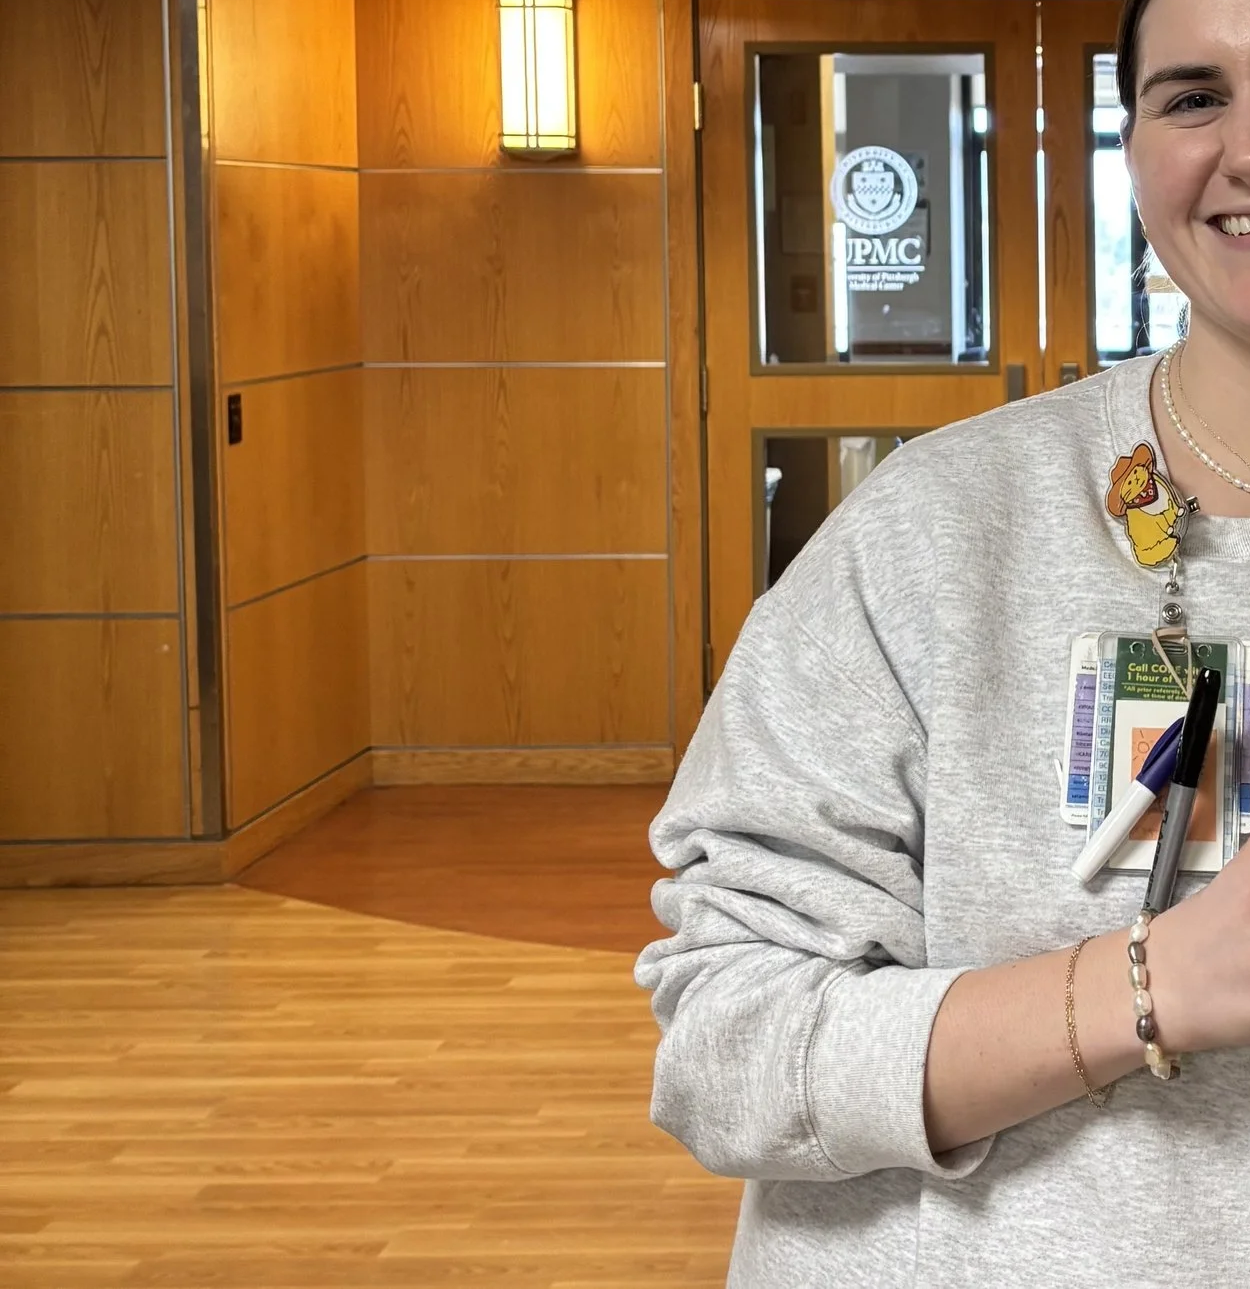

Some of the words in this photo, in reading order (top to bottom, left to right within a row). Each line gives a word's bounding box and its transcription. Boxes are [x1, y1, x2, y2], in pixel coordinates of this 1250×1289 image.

[1128, 663, 1148, 672] Call
[1151, 664, 1181, 675] COE
[1136, 672, 1159, 683] hour
[1162, 674, 1173, 683] of
